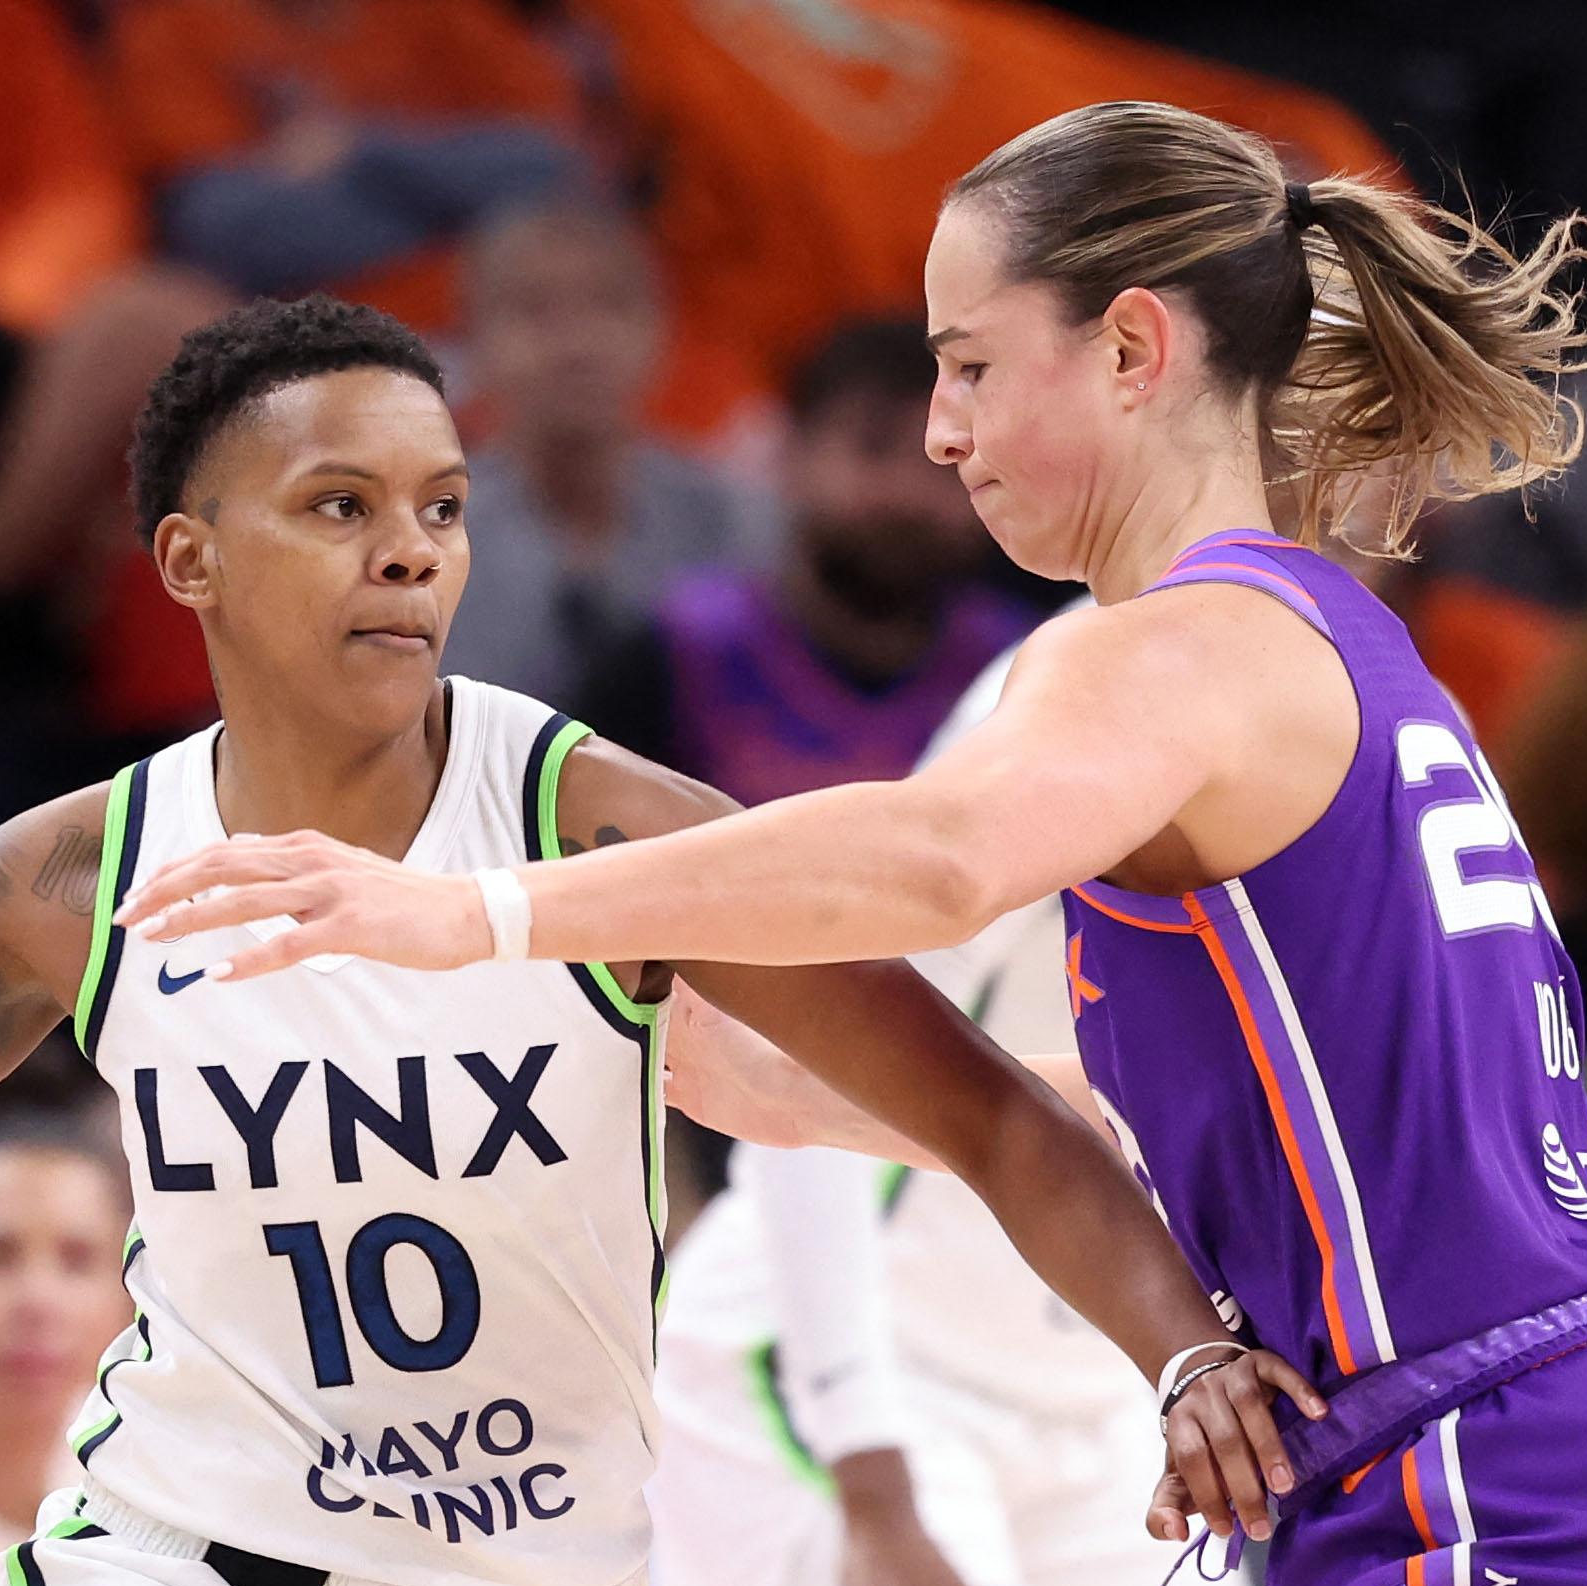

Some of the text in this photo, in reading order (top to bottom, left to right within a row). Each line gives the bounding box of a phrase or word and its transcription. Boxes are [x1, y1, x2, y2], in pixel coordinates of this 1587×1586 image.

[1395, 718, 1564, 948] 2
[134, 1043, 569, 1192] LYNX
[262, 1212, 481, 1389] 10
[320, 1398, 533, 1479] MAYO
